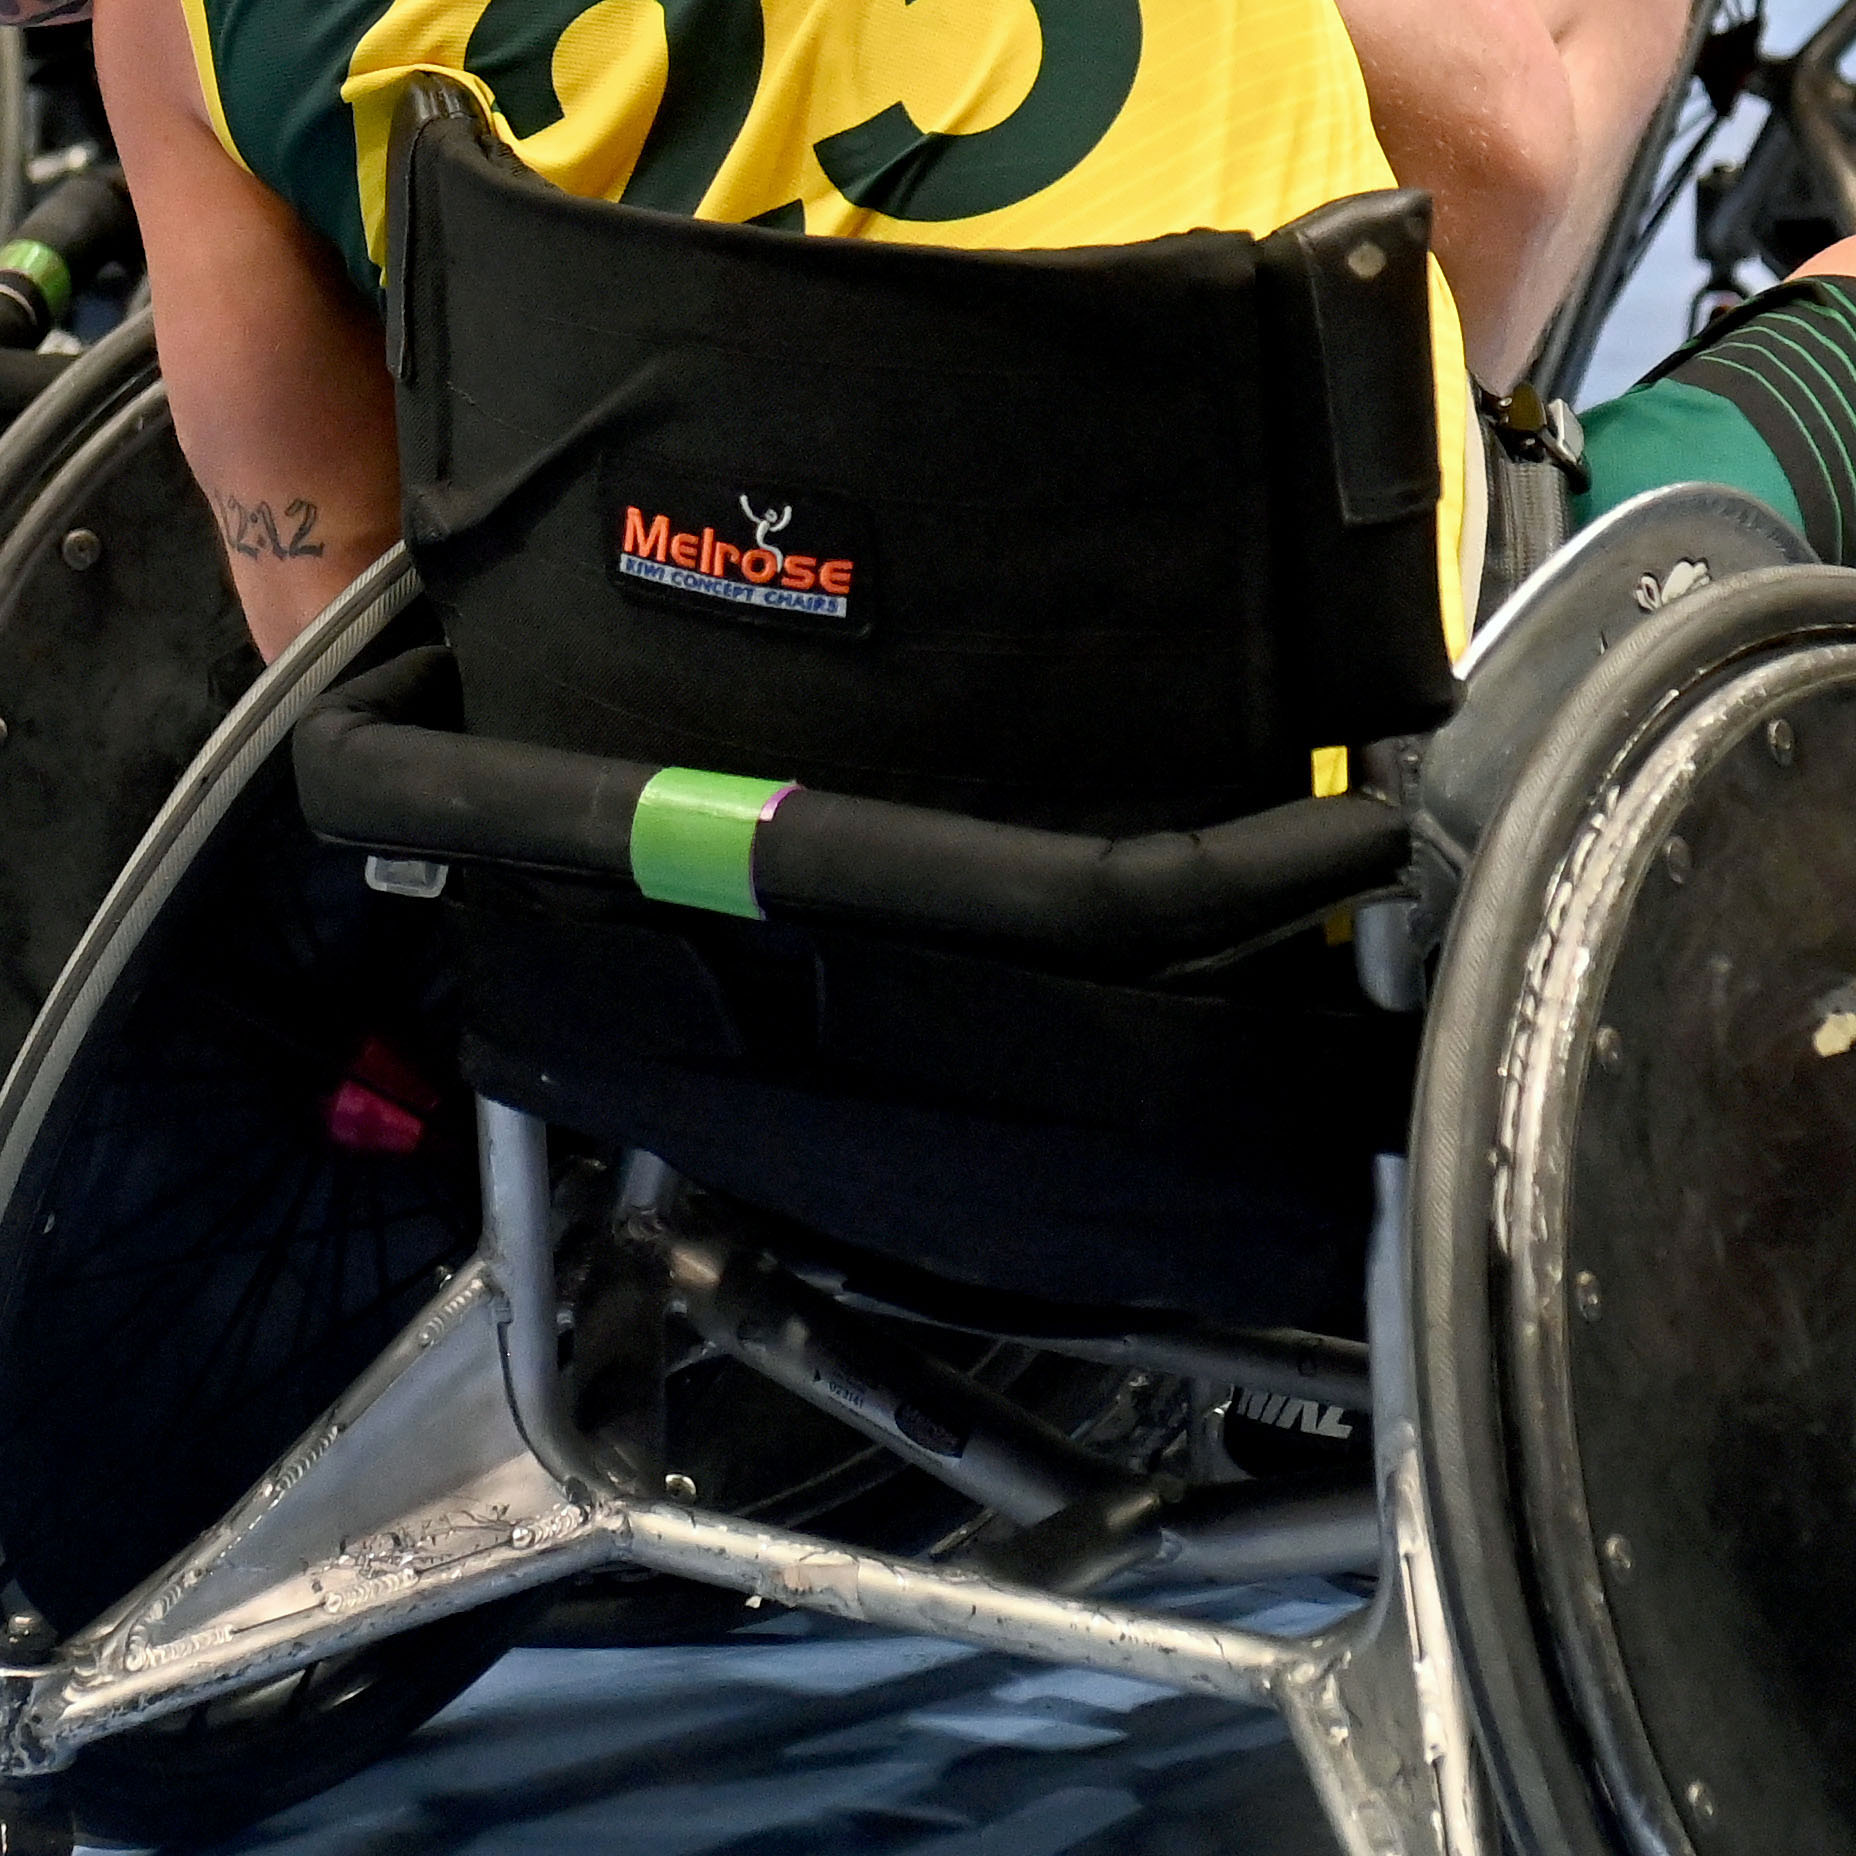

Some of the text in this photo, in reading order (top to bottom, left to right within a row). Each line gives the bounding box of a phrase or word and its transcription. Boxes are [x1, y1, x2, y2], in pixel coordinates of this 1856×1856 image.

[623, 505, 854, 595] Melrose
[626, 556, 840, 615] KIWI CONCEPT CHAIRS
